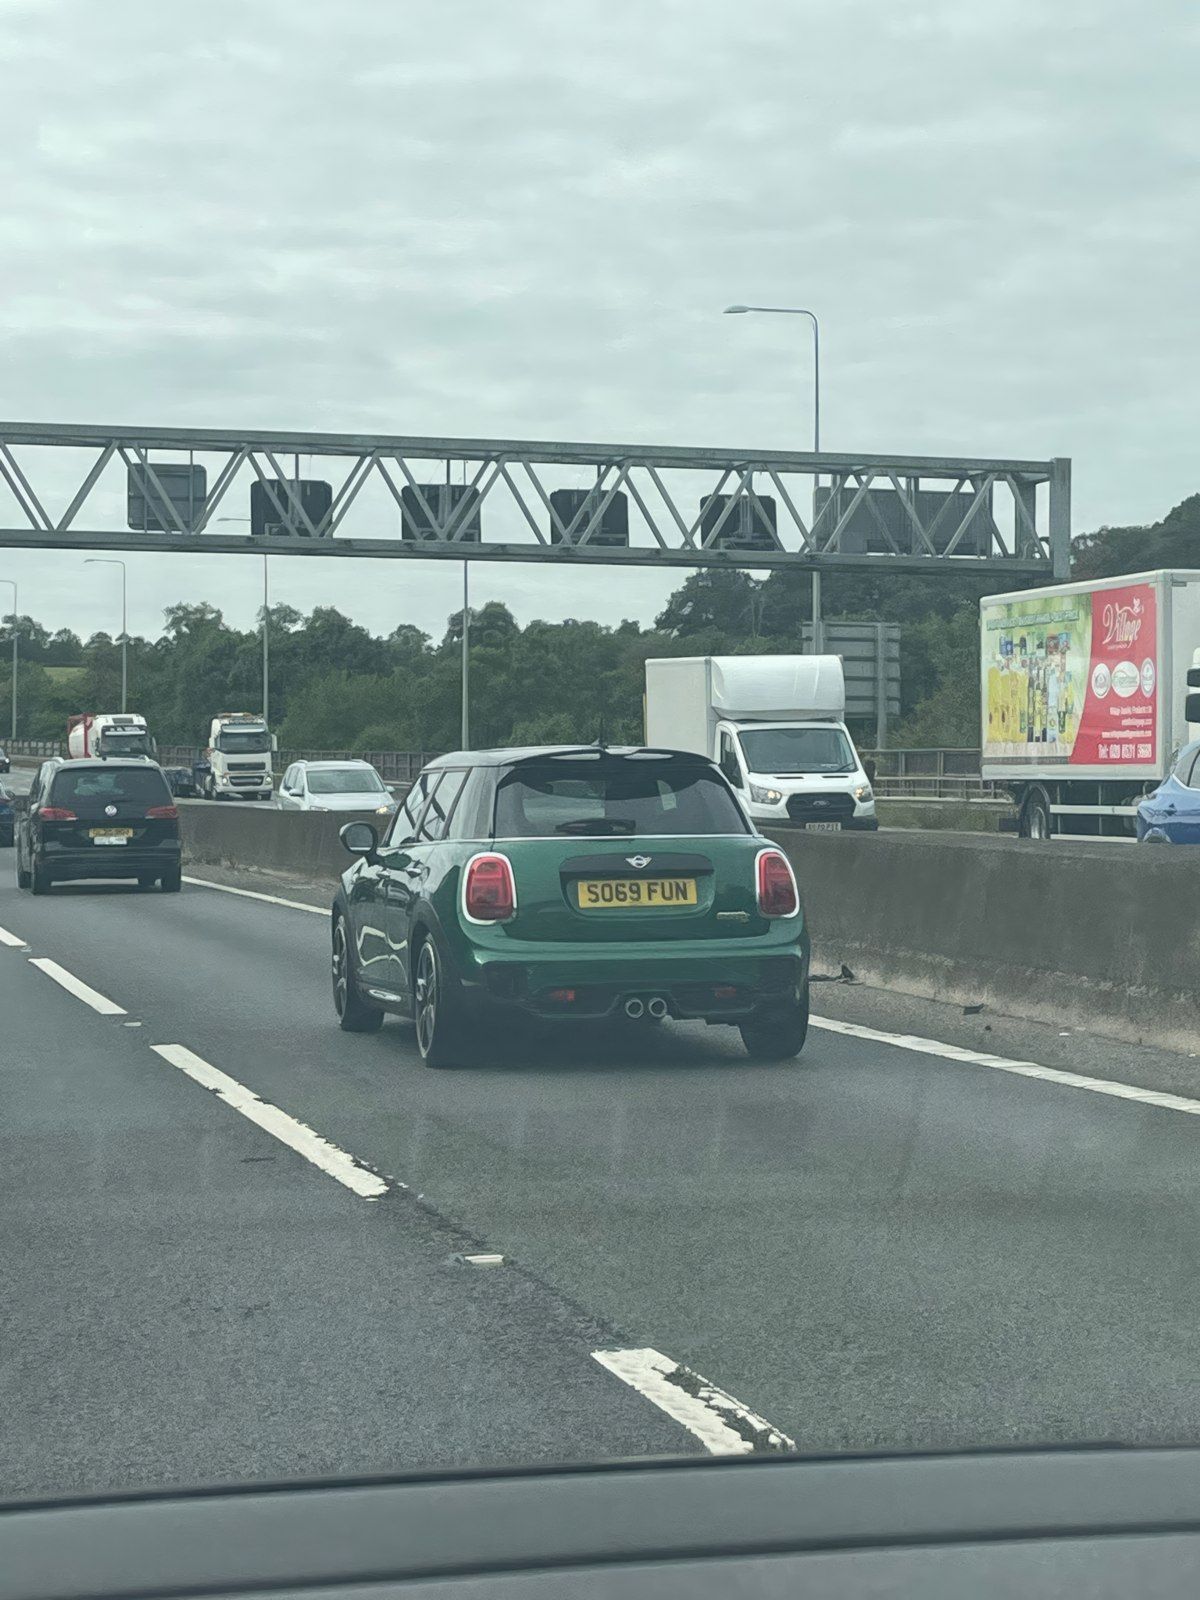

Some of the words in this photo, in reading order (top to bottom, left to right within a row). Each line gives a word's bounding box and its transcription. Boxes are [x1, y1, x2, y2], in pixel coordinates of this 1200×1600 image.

[1102, 602, 1141, 648] Village
[587, 882, 641, 904] SO69
[647, 881, 688, 901] FUN
